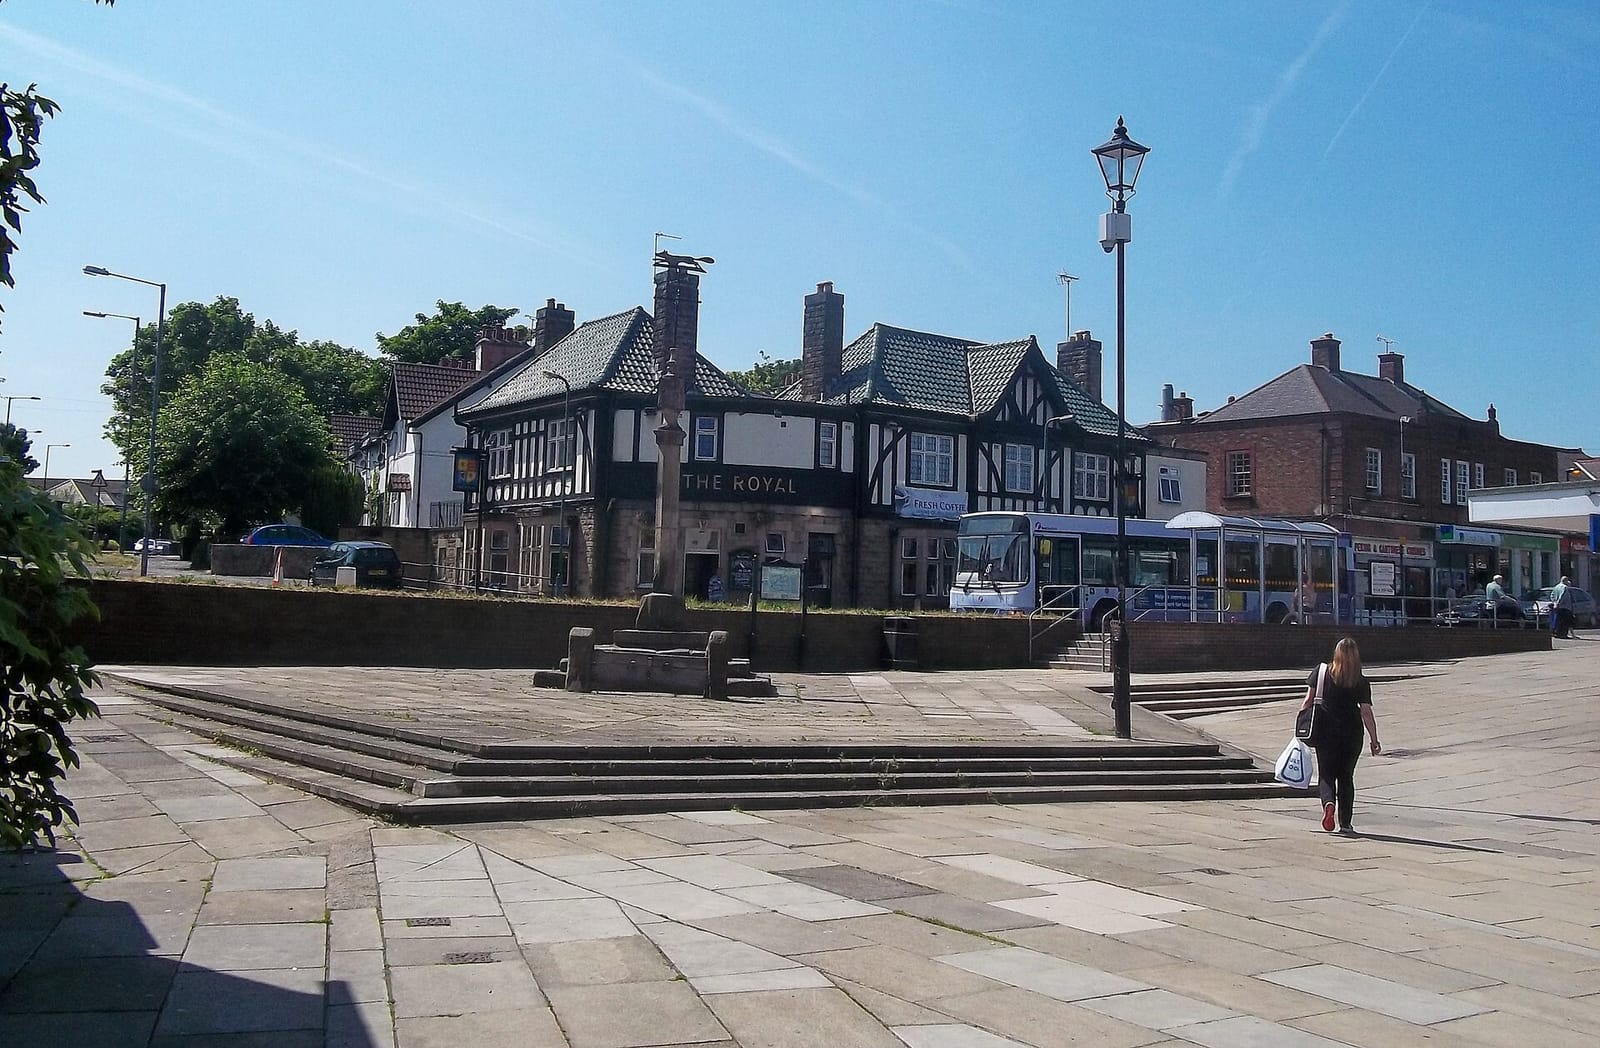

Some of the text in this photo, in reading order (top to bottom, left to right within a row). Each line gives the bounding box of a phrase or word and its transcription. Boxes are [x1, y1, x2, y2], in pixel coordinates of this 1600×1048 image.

[682, 474, 797, 494] THE ROYAL
[914, 499, 938, 509] FRESH
